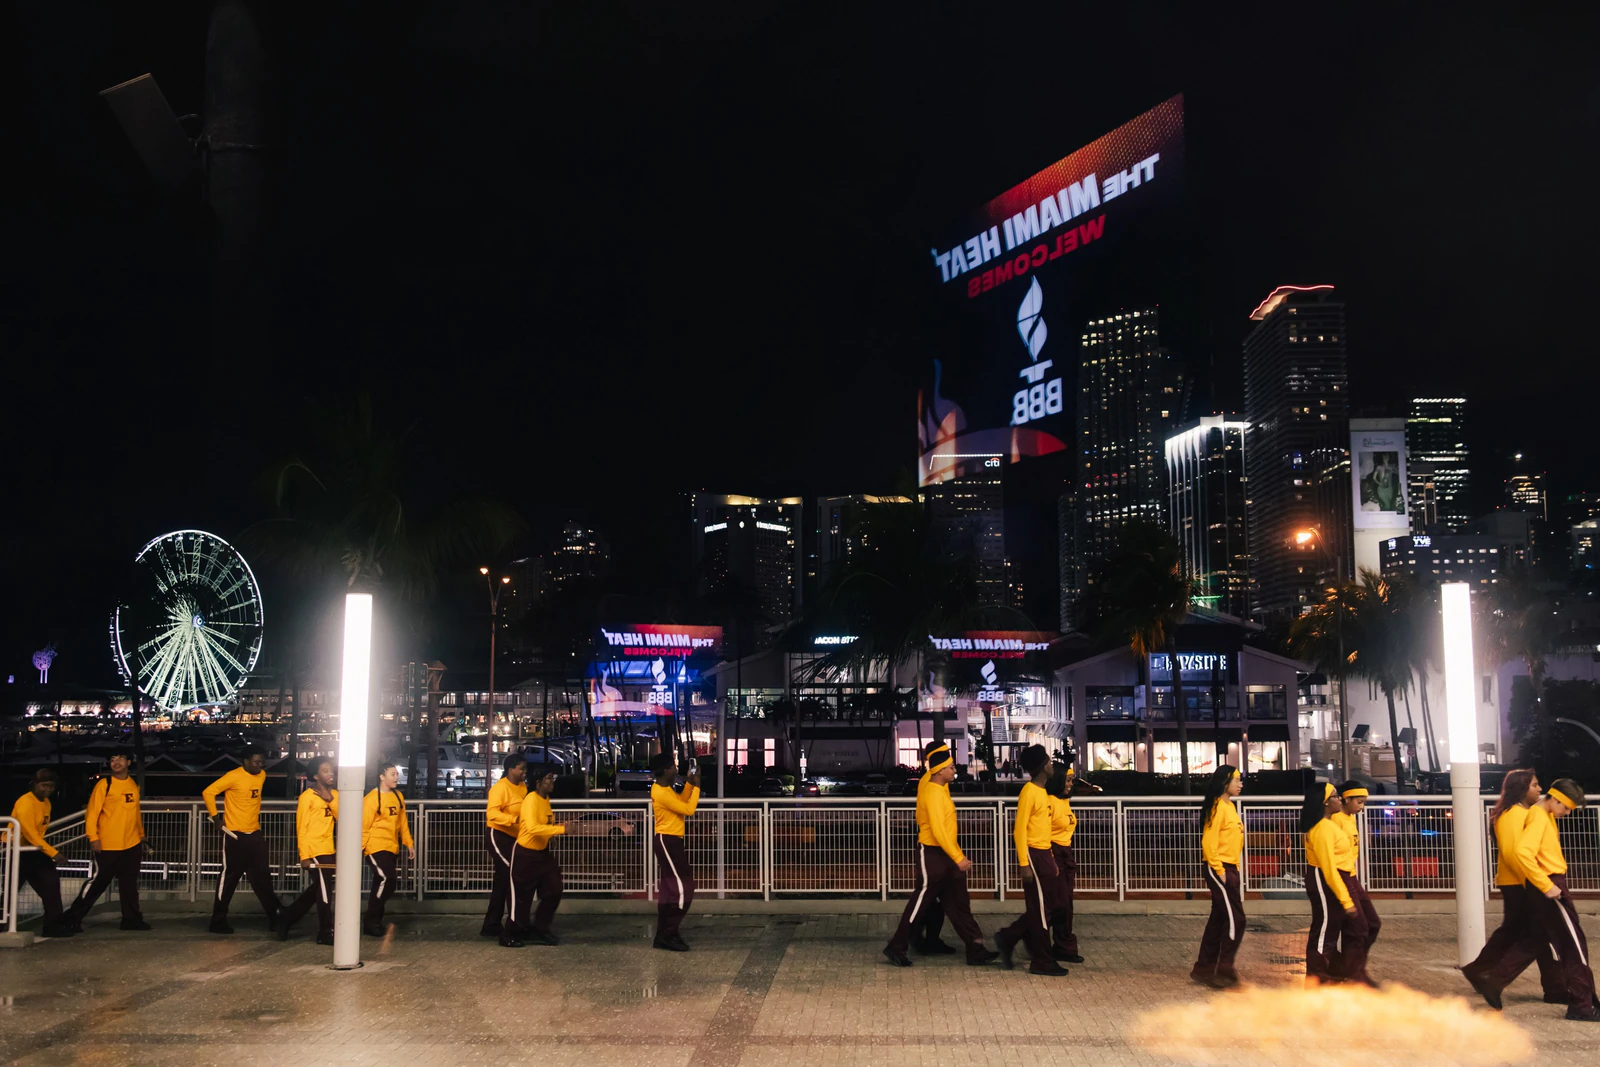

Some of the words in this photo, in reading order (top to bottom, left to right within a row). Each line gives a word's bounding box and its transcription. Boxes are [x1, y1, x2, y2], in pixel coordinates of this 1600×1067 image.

[984, 458, 1001, 467] citi
[125, 793, 135, 803] E
[250, 789, 260, 799] E
[324, 806, 333, 817] E
[389, 806, 399, 816] E
